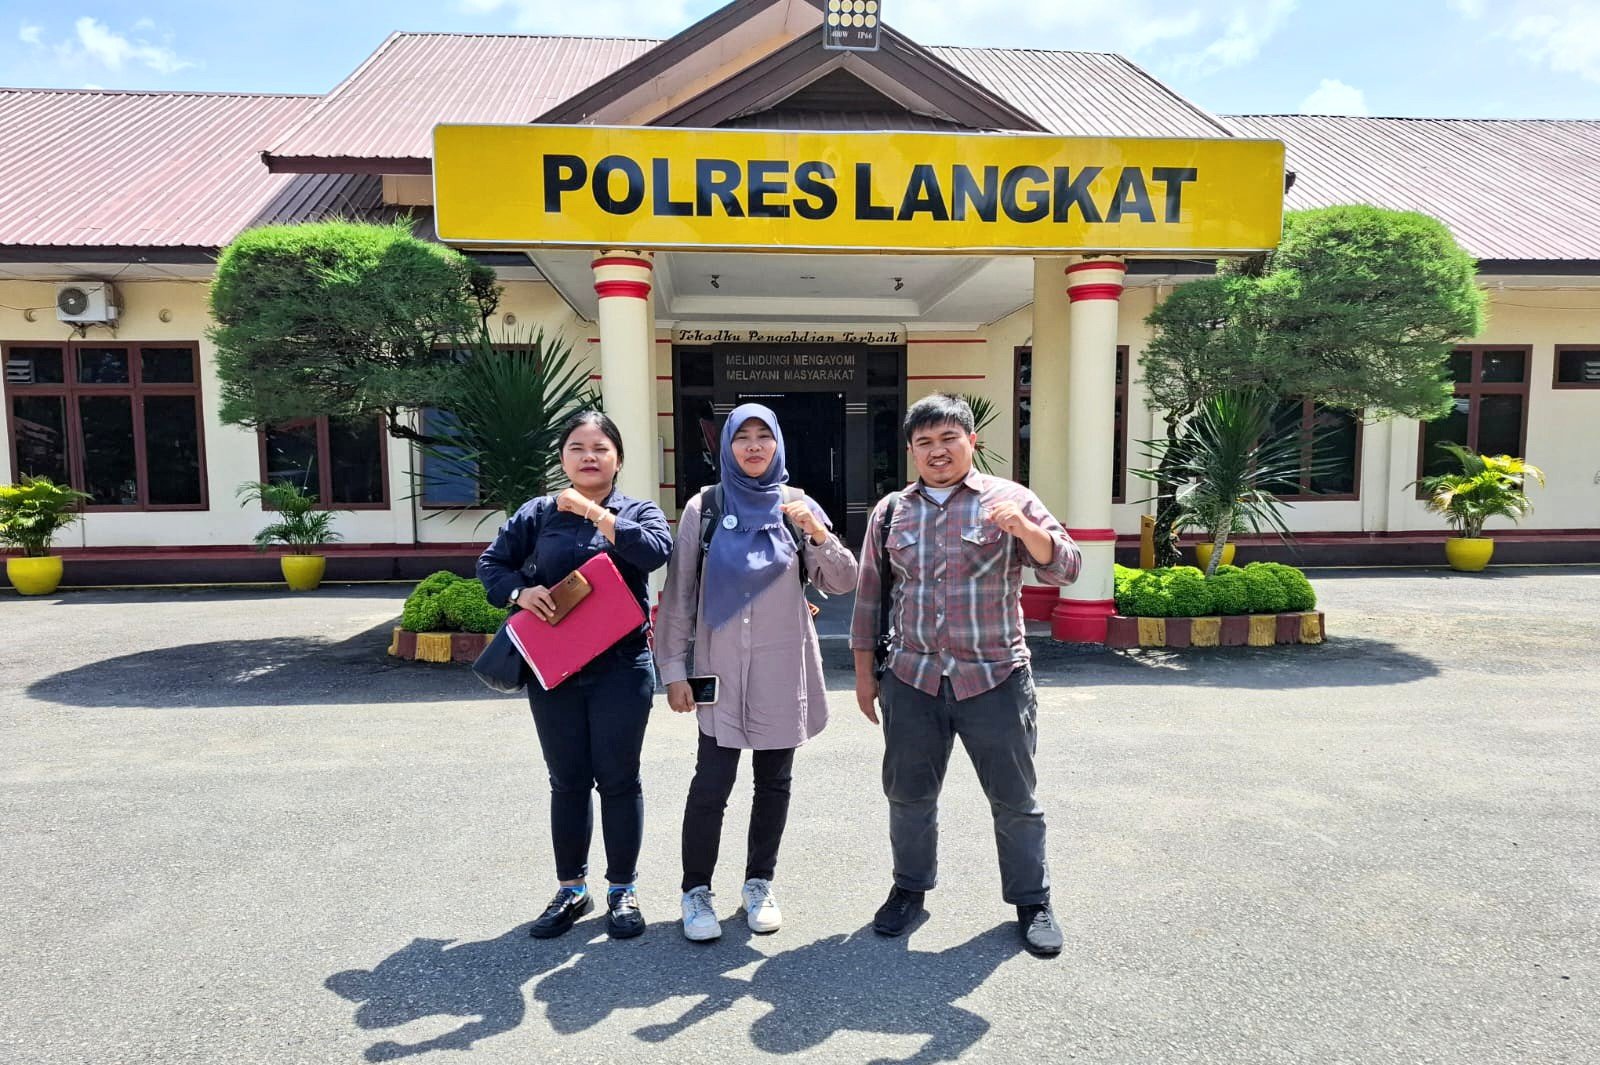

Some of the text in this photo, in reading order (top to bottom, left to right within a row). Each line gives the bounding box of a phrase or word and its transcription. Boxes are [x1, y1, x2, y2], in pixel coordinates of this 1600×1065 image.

[543, 154, 1198, 223] POLRES LANGKAT
[679, 329, 899, 343] Tekadku Pengabdian Terbaik
[726, 354, 855, 365] MELINDUNGI MENGAYOMI
[726, 370, 855, 381] MELAYANI MASYARAKAT
